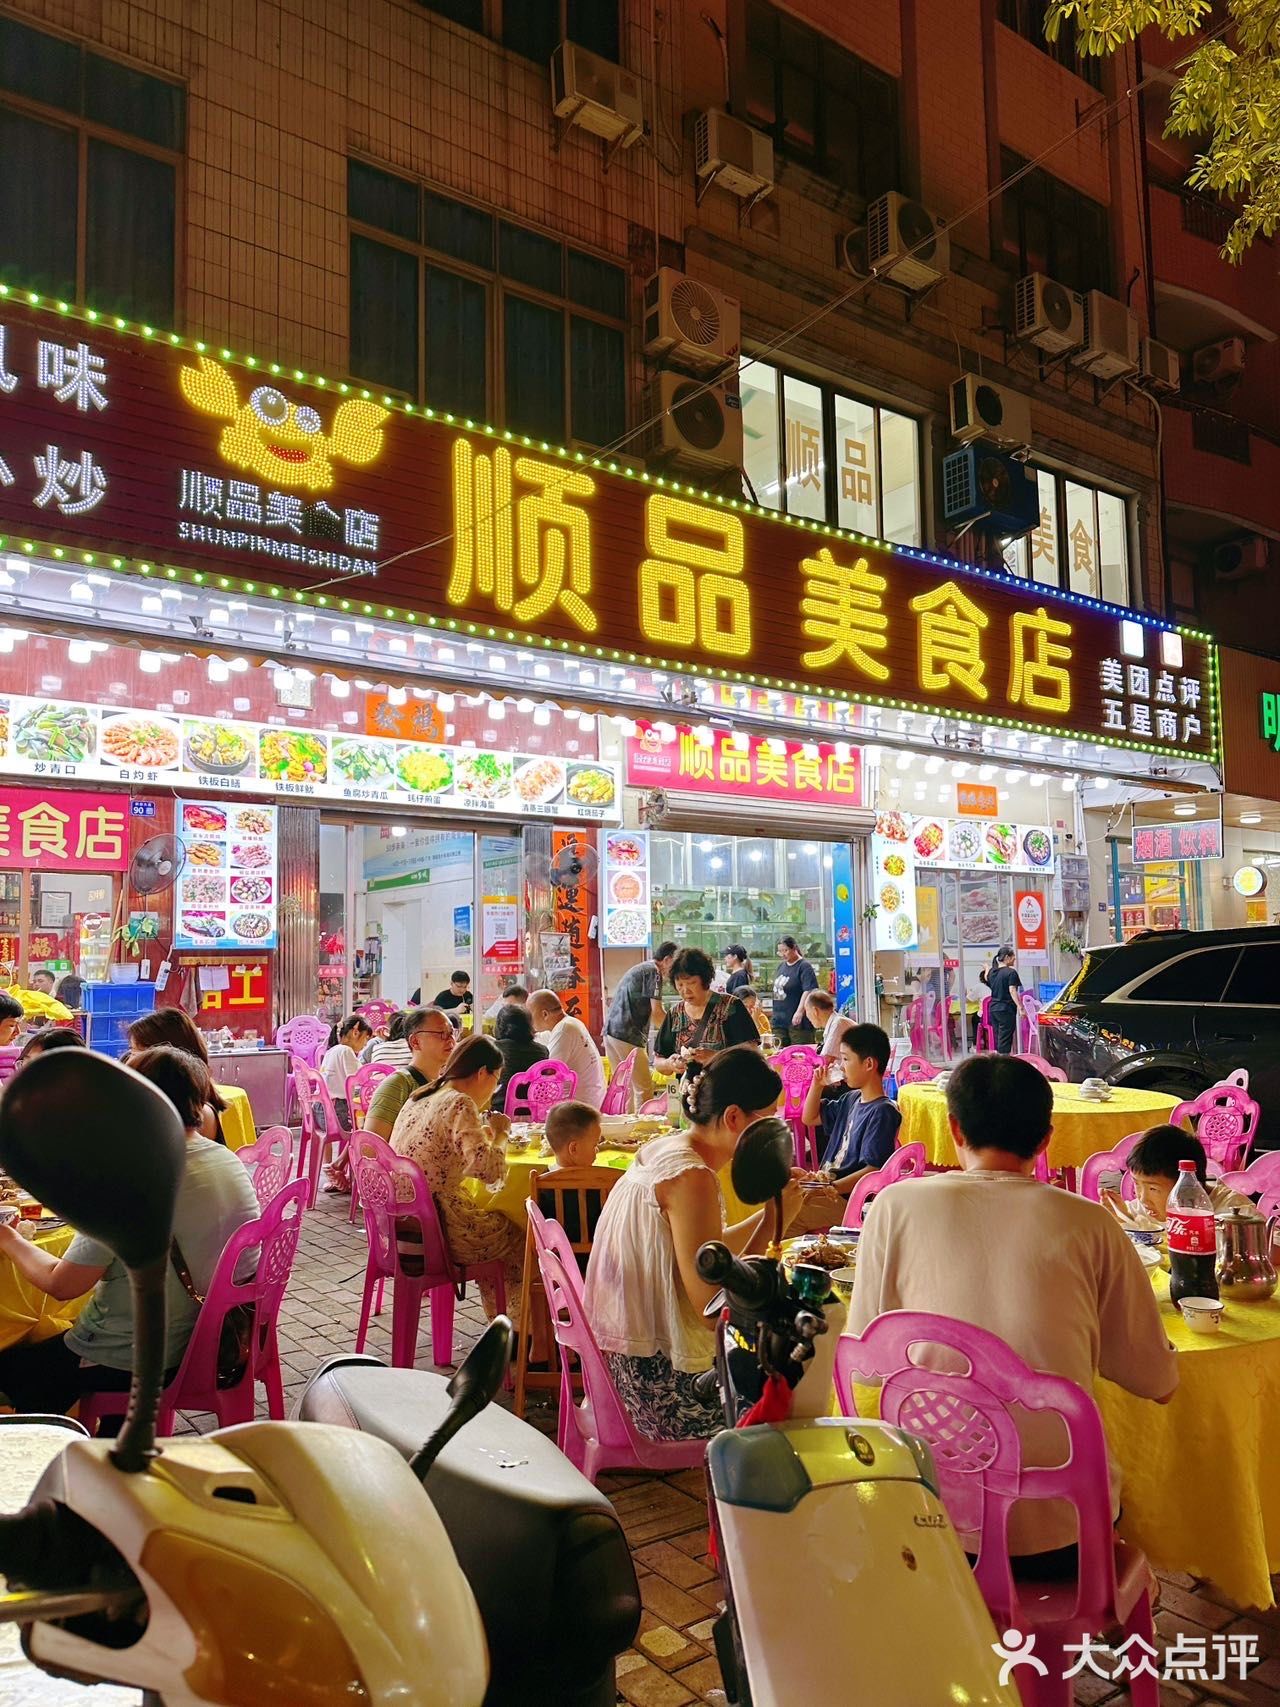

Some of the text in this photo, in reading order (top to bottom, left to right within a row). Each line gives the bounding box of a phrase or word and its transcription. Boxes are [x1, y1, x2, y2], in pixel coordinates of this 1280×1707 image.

[0, 444, 108, 515] 炒
[787, 418, 873, 506] 顺品
[447, 437, 1073, 713] 顺品美食店
[1100, 657, 1202, 709] 美团点评
[1101, 698, 1202, 743] 五星商户
[34, 761, 76, 775] 炒青口
[119, 769, 158, 782] 白灼虾
[678, 730, 855, 793] 顺品美食店
[0, 801, 125, 860] 食店
[1135, 825, 1218, 859] 烟酒 饮料
